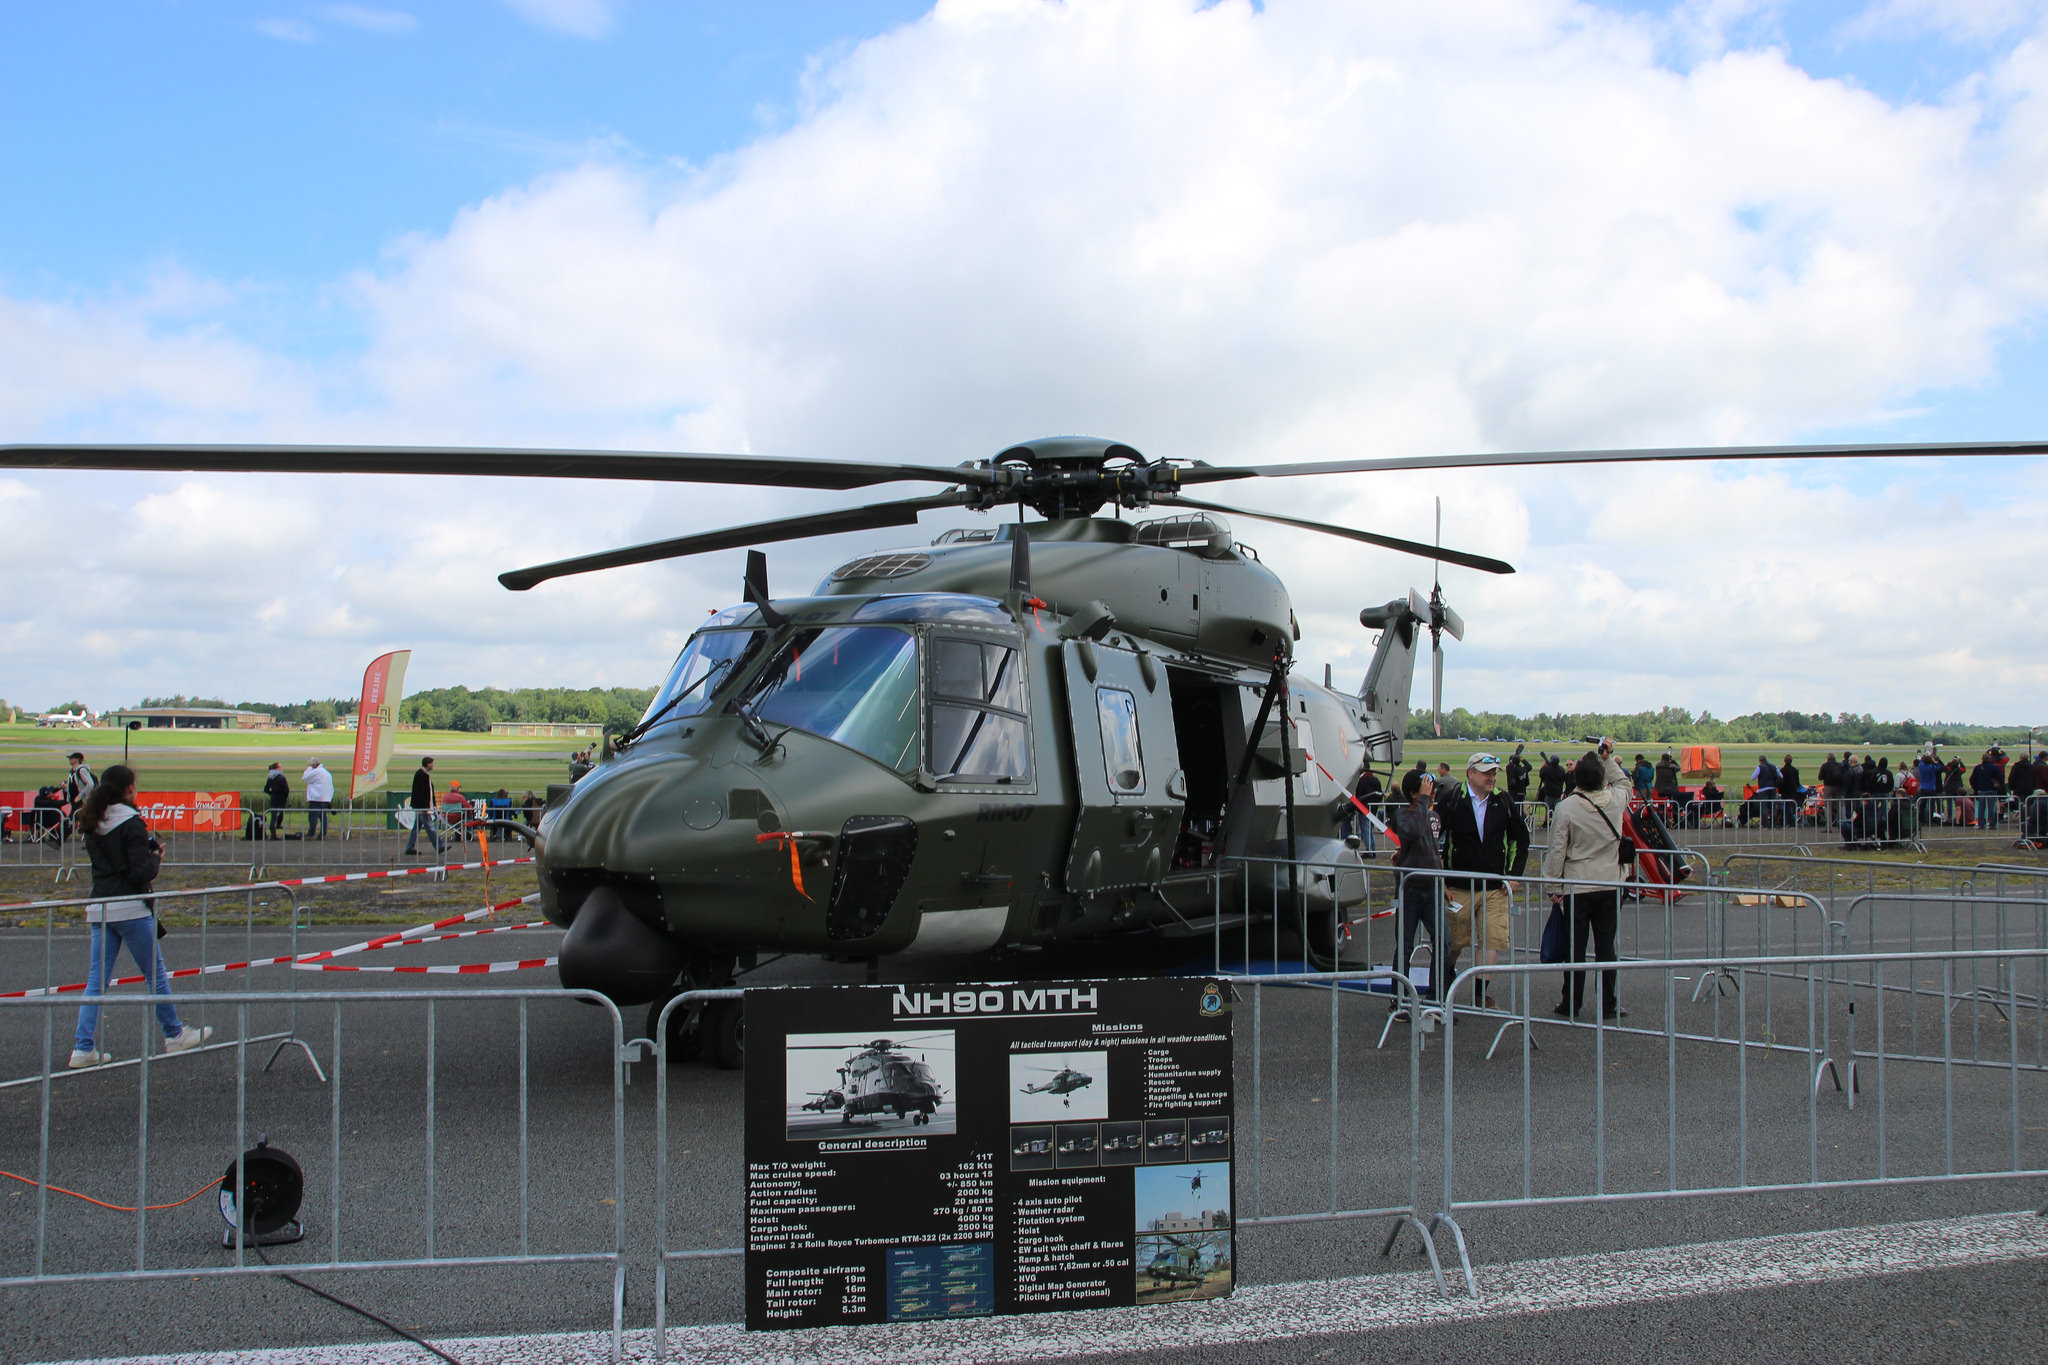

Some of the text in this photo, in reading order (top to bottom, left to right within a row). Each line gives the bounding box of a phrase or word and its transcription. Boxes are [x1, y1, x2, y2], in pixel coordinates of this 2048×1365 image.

[893, 987, 1098, 1015] NH90 MTH
[1092, 1023, 1143, 1032] Missions
[1010, 1033, 1227, 1049] All tactical transport (day & night) missions in all weather conditions.
[1148, 1056, 1173, 1064] Troops
[1148, 1069, 1222, 1078] Humanitarian supply
[1148, 1092, 1186, 1102] Rappelling
[1164, 1100, 1192, 1109] fighting
[1194, 1099, 1221, 1107] support
[818, 1138, 927, 1150] General description
[976, 1153, 993, 1161] 11T
[750, 1161, 826, 1171] Max T/O weight:
[958, 1162, 993, 1170] 162 Kts
[750, 1169, 836, 1180] Max cruise speed:
[940, 1172, 951, 1180] 03
[982, 1170, 993, 1178] 15
[960, 1180, 977, 1188] 850
[1029, 1175, 1106, 1187] Mission equipment:
[750, 1188, 816, 1197] Action radius:
[957, 1188, 993, 1196] 2000 kg
[750, 1197, 817, 1206] Fuel capacity:
[1018, 1195, 1082, 1206] 4 axis auto pilot
[750, 1204, 856, 1215] Maximum passengers:
[933, 1207, 950, 1215] 270
[952, 1207, 964, 1215] kg
[971, 1205, 982, 1213] 80
[1018, 1205, 1074, 1216] Weather radar
[750, 1216, 778, 1224] Hoist:
[957, 1214, 994, 1222] 4000 kg
[1018, 1215, 1085, 1226] Flotation system
[750, 1223, 807, 1234] Cargo hook:
[958, 1222, 994, 1231] 2500 kg
[1018, 1226, 1040, 1235] Hoist
[750, 1232, 814, 1242] Internal load:
[750, 1242, 786, 1252] Engines:
[790, 1241, 796, 1249] 2
[805, 1240, 826, 1248] Rolls
[828, 1240, 852, 1248] Royce
[854, 1237, 900, 1245] Turbomeca
[902, 1234, 936, 1243] RTM-322
[953, 1232, 972, 1240] 2200
[974, 1229, 994, 1239] SHP)
[1018, 1234, 1064, 1245] Cargo hook
[1018, 1246, 1031, 1254] EW
[1033, 1245, 1048, 1253] suit
[1050, 1243, 1068, 1252] with
[1070, 1242, 1091, 1251] chaff
[1101, 1241, 1124, 1249] flares
[1018, 1252, 1074, 1264] Ramp & hatch
[1018, 1263, 1057, 1274] Weapons:
[1116, 1258, 1129, 1266] cal
[766, 1266, 866, 1278] Composite airframe
[766, 1277, 824, 1288] Full length:
[844, 1275, 866, 1283] 19m
[1019, 1274, 1036, 1283] NVG
[845, 1285, 866, 1293] 16m
[1019, 1280, 1106, 1293] Digital Map Generator
[766, 1288, 822, 1298] Main rotor:
[1019, 1288, 1110, 1302] Piloting FLIR (optional)
[766, 1298, 816, 1308] Tail rotor:
[842, 1295, 866, 1304] 3.2m
[766, 1308, 802, 1319] Height:
[842, 1305, 866, 1314] 5.3m
